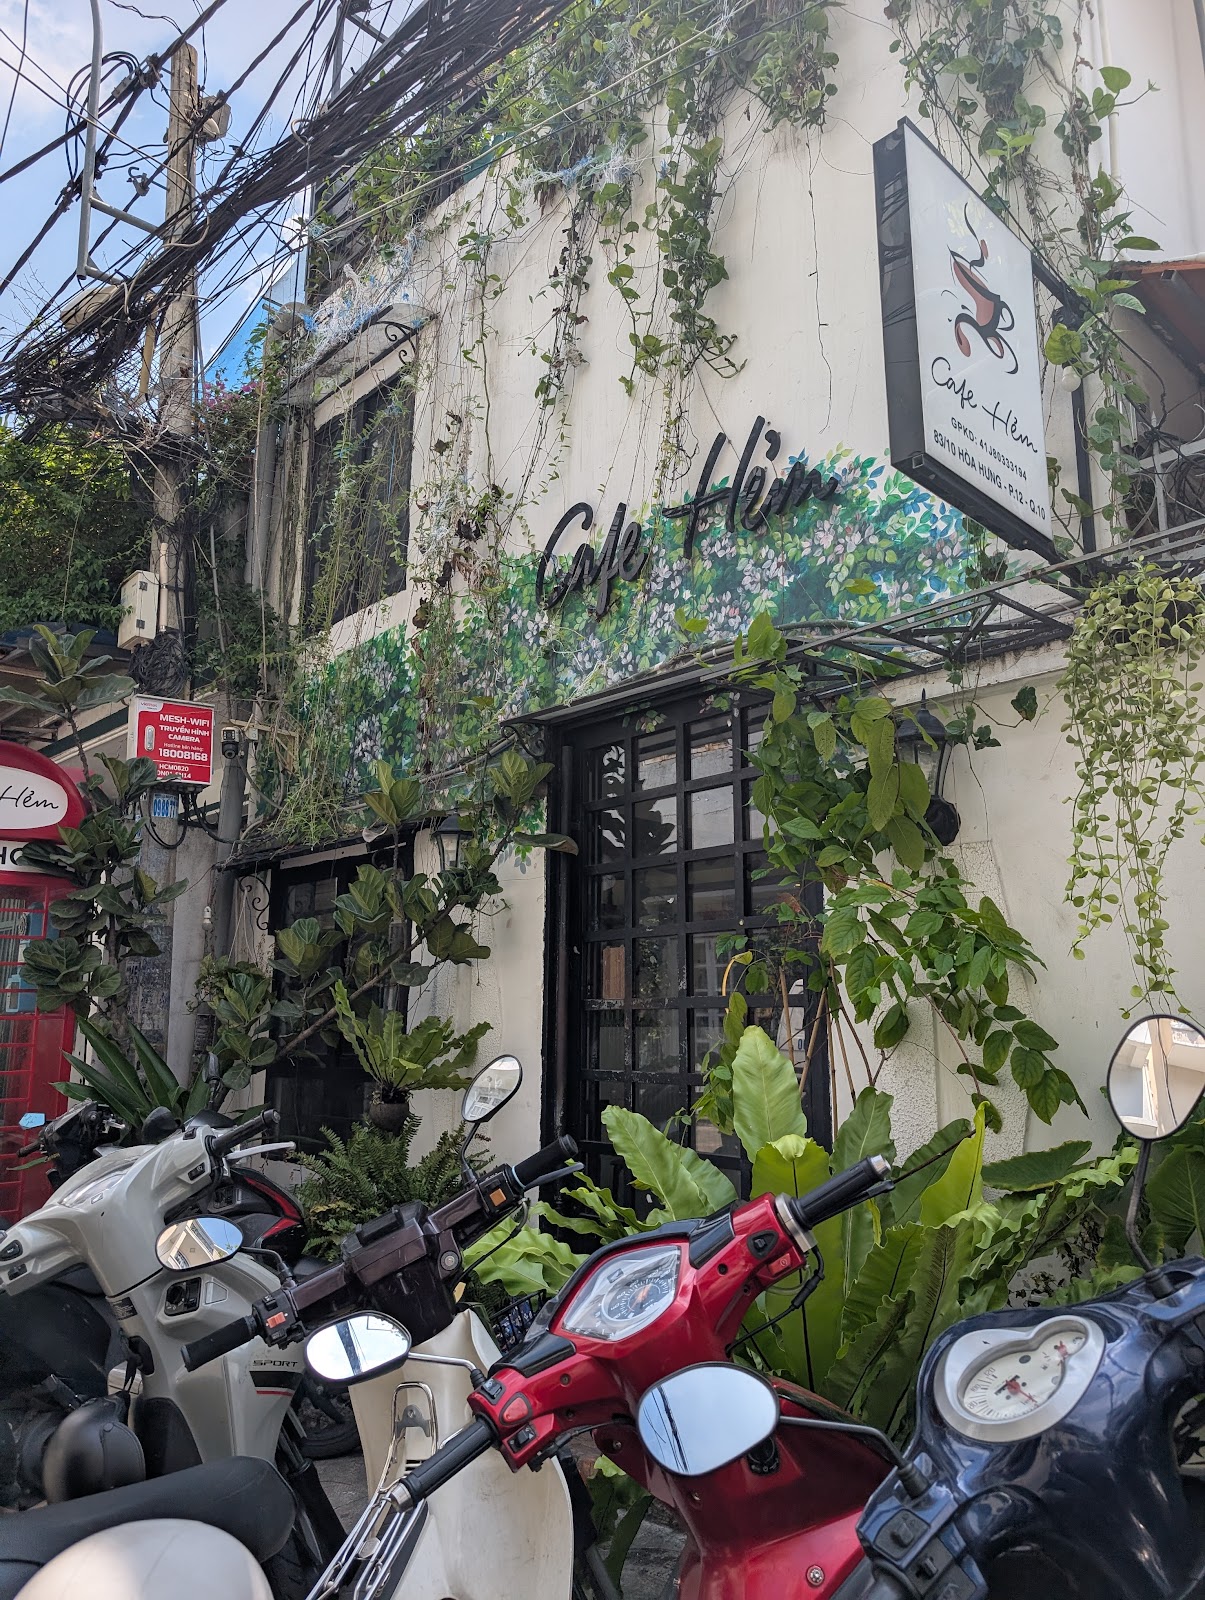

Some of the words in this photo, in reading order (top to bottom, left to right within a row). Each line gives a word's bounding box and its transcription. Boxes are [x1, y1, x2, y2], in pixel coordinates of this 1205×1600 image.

[931, 356, 978, 409] Cafe
[981, 401, 1039, 453] Hẻm
[951, 416, 978, 446] GPKD:
[933, 429, 957, 456] 83/10
[957, 446, 977, 472] HÒA
[1008, 483, 1024, 505] P.12
[1029, 498, 1046, 520] Q.10
[536, 501, 648, 616] Cafe
[159, 714, 209, 727] MESH-WIFI
[168, 734, 200, 743] CAMERA
[158, 748, 208, 761] 18008168
[0, 785, 59, 809] Hẻm
